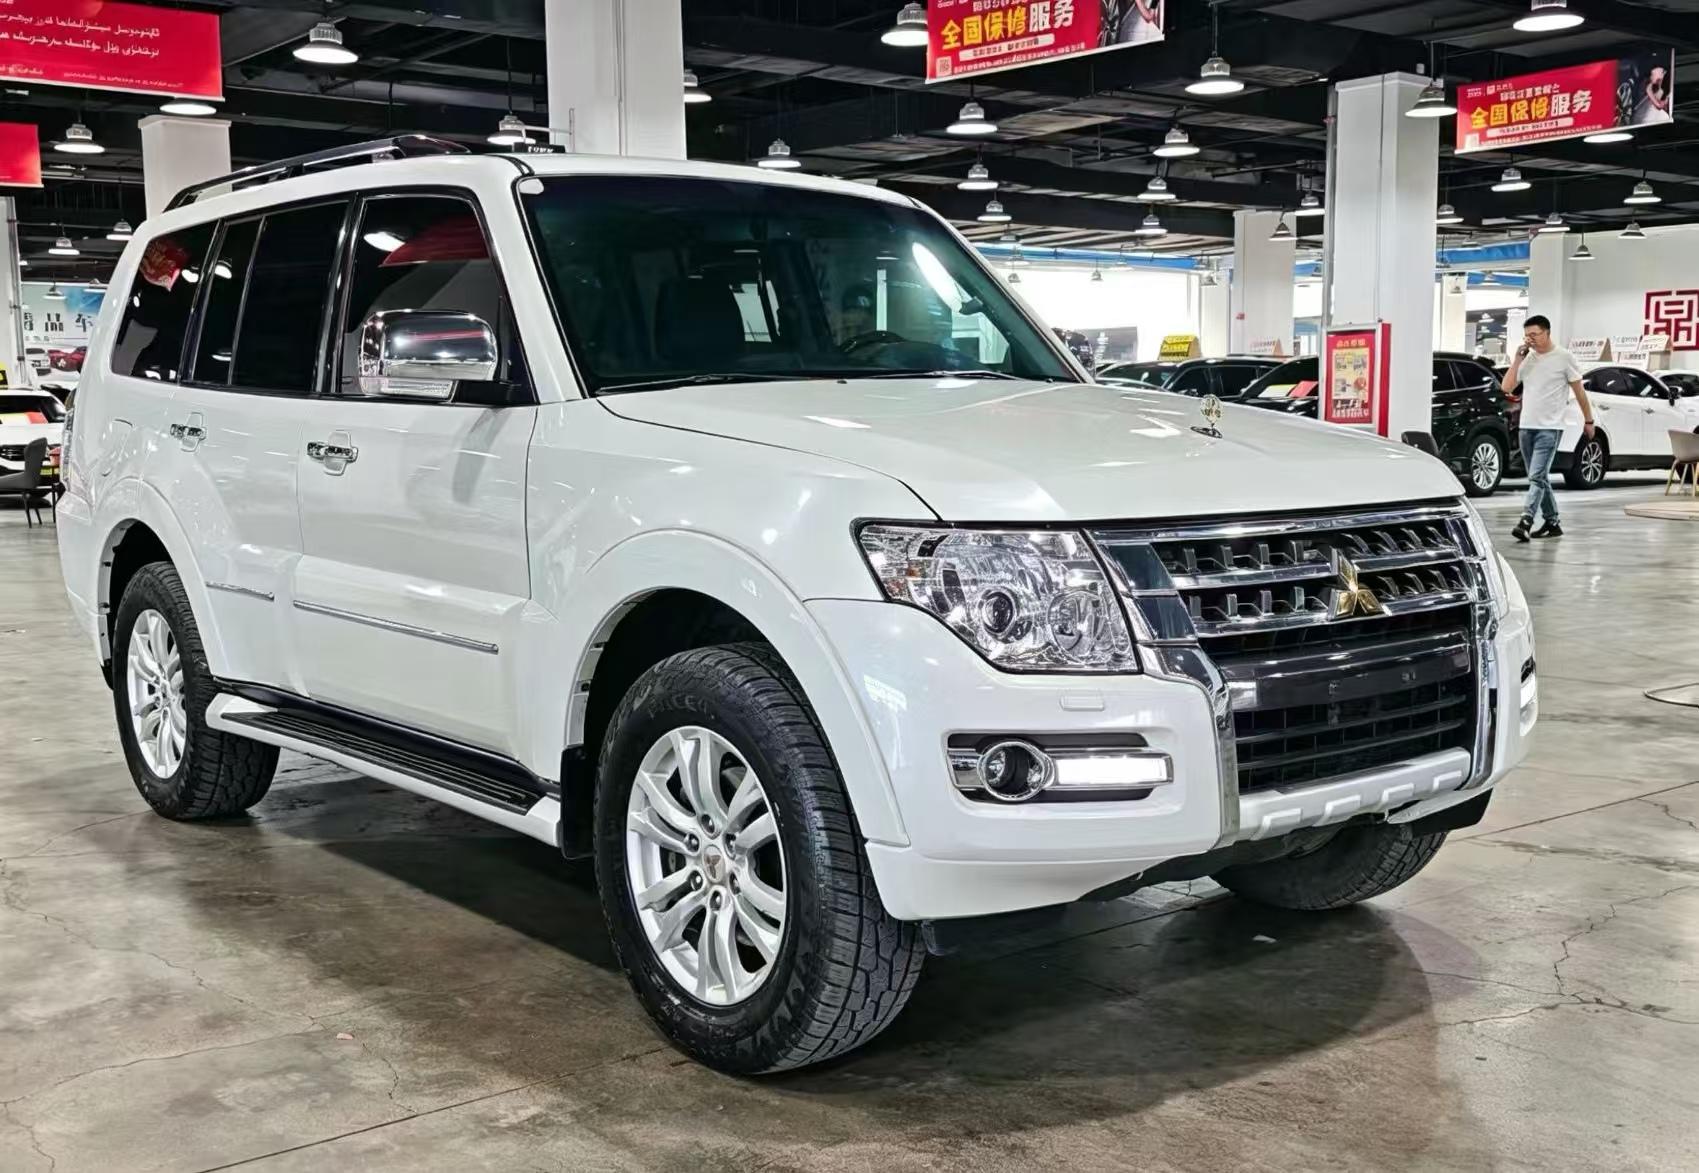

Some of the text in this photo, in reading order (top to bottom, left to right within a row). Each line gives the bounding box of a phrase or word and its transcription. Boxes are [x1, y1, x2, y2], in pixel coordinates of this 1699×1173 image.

[941, 0, 1075, 50] 全国保修服务
[1470, 90, 1593, 129] 全国保修服务
